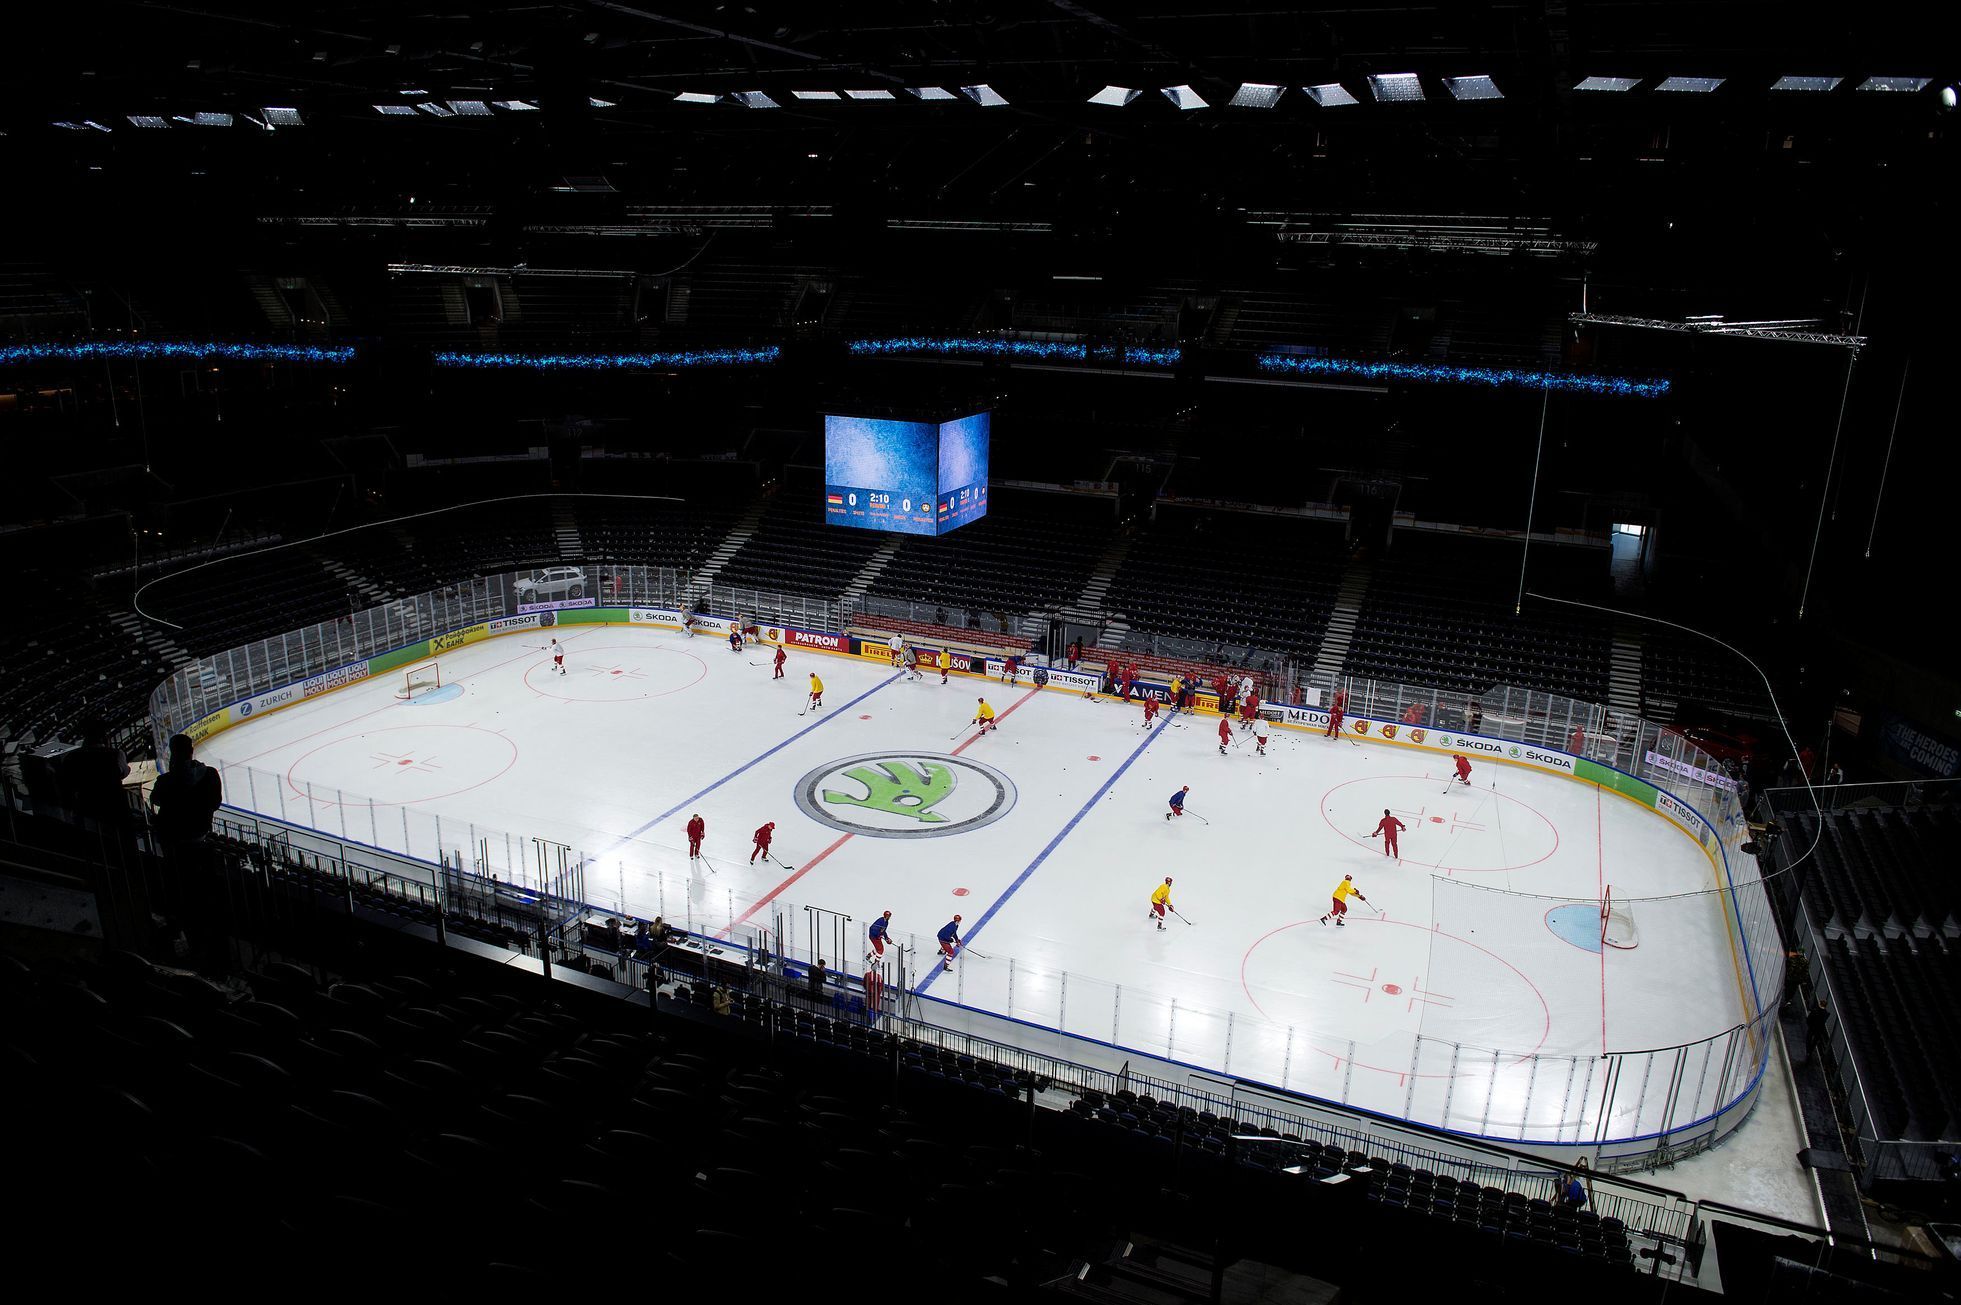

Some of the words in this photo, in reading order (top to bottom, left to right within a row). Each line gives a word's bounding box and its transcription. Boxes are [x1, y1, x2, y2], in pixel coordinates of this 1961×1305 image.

[848, 493, 857, 506] 0
[870, 492, 889, 504] 2:10
[950, 496, 955, 509] 0
[902, 498, 911, 512] 0
[503, 615, 537, 627] TISSOT
[646, 612, 678, 622] ŠKODA
[446, 638, 464, 649] БАНК
[795, 632, 839, 647] PATRON
[350, 670, 368, 681] MOLY
[1000, 665, 1032, 676] TSOT
[327, 677, 347, 689] MOLY
[1064, 676, 1097, 687] TISSOT
[304, 684, 325, 696] MOLY
[260, 691, 292, 708] ZURICH
[1288, 709, 1343, 725] MEDO
[1457, 738, 1502, 753] ŠKODA
[1526, 750, 1571, 769] ŠKODA
[1673, 802, 1700, 829] TISSOT
